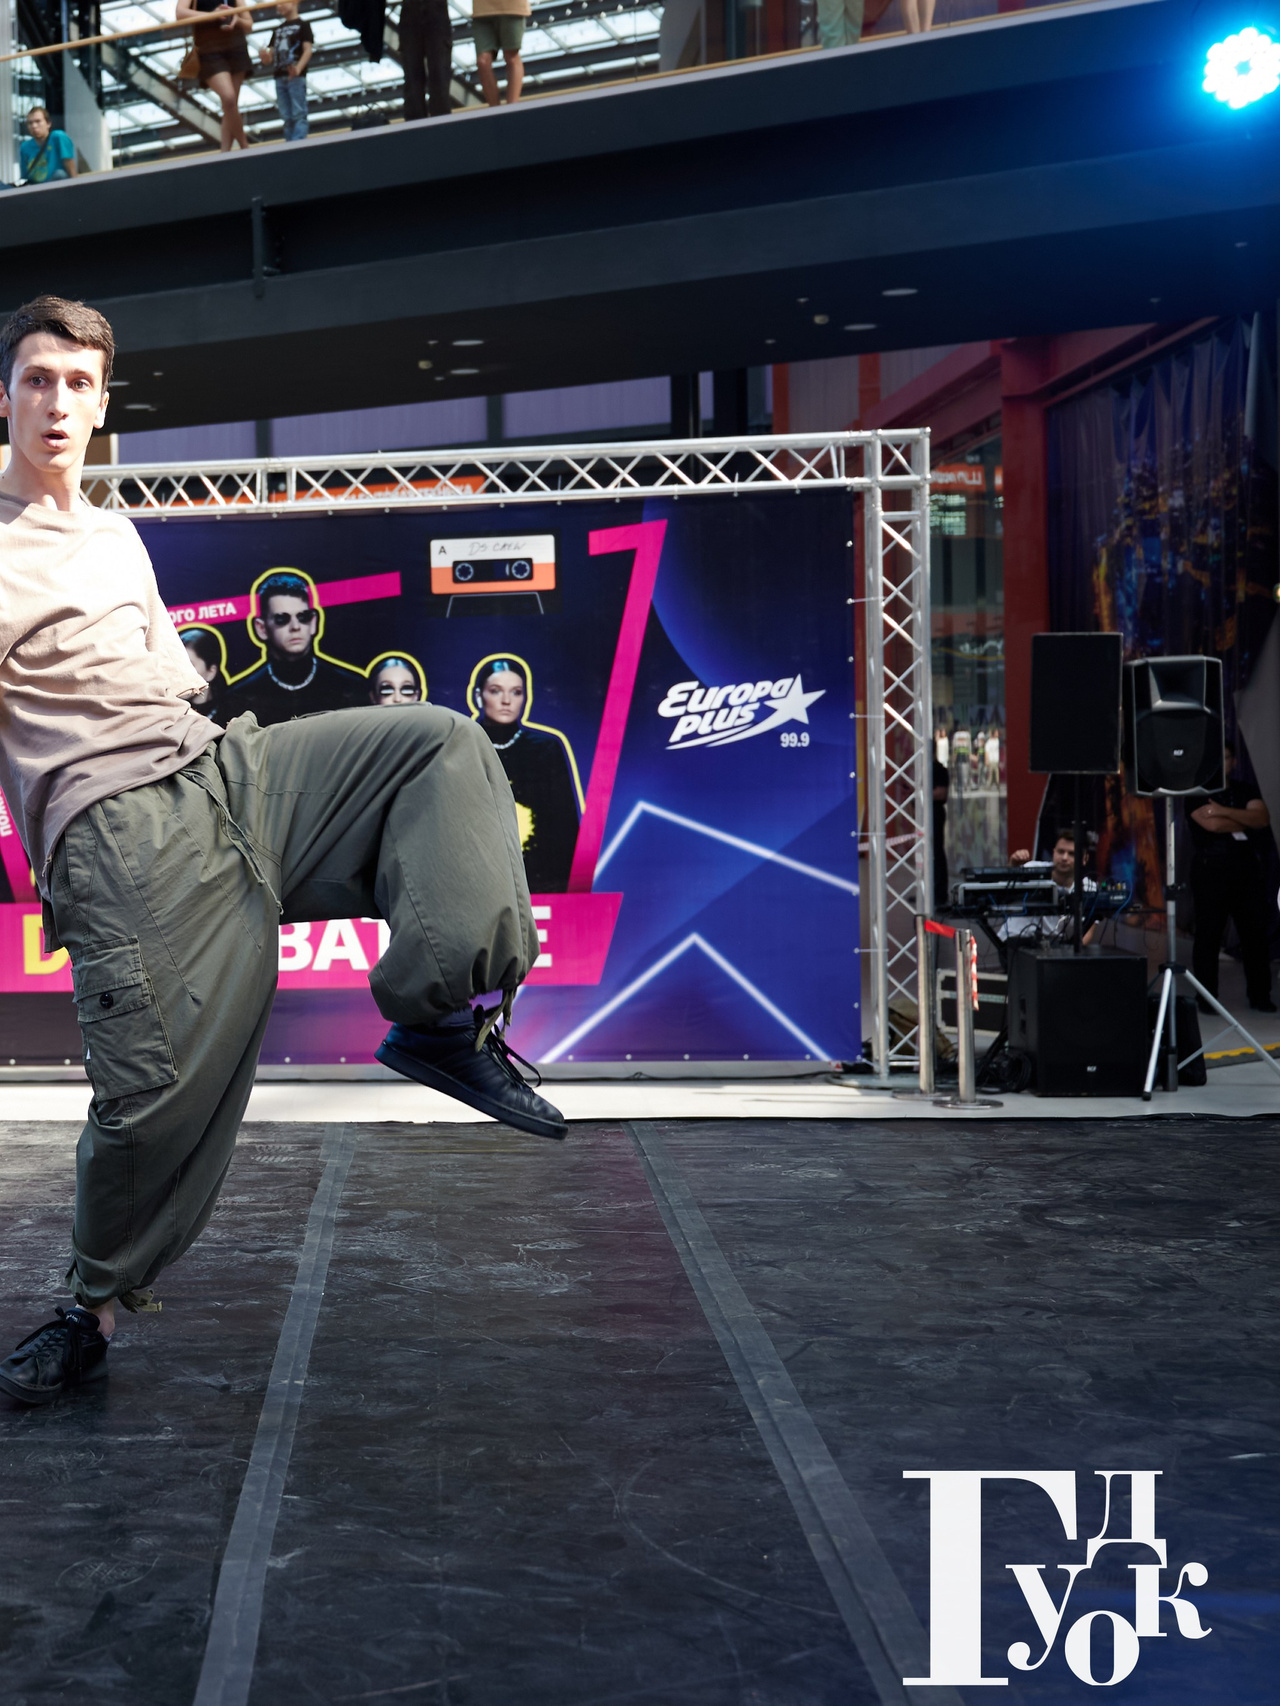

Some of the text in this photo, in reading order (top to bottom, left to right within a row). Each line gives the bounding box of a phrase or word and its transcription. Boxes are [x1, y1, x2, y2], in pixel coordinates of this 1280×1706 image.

[438, 545, 447, 555] A
[169, 602, 237, 624] ОГО ЛЕТА
[779, 731, 810, 748] 99.9
